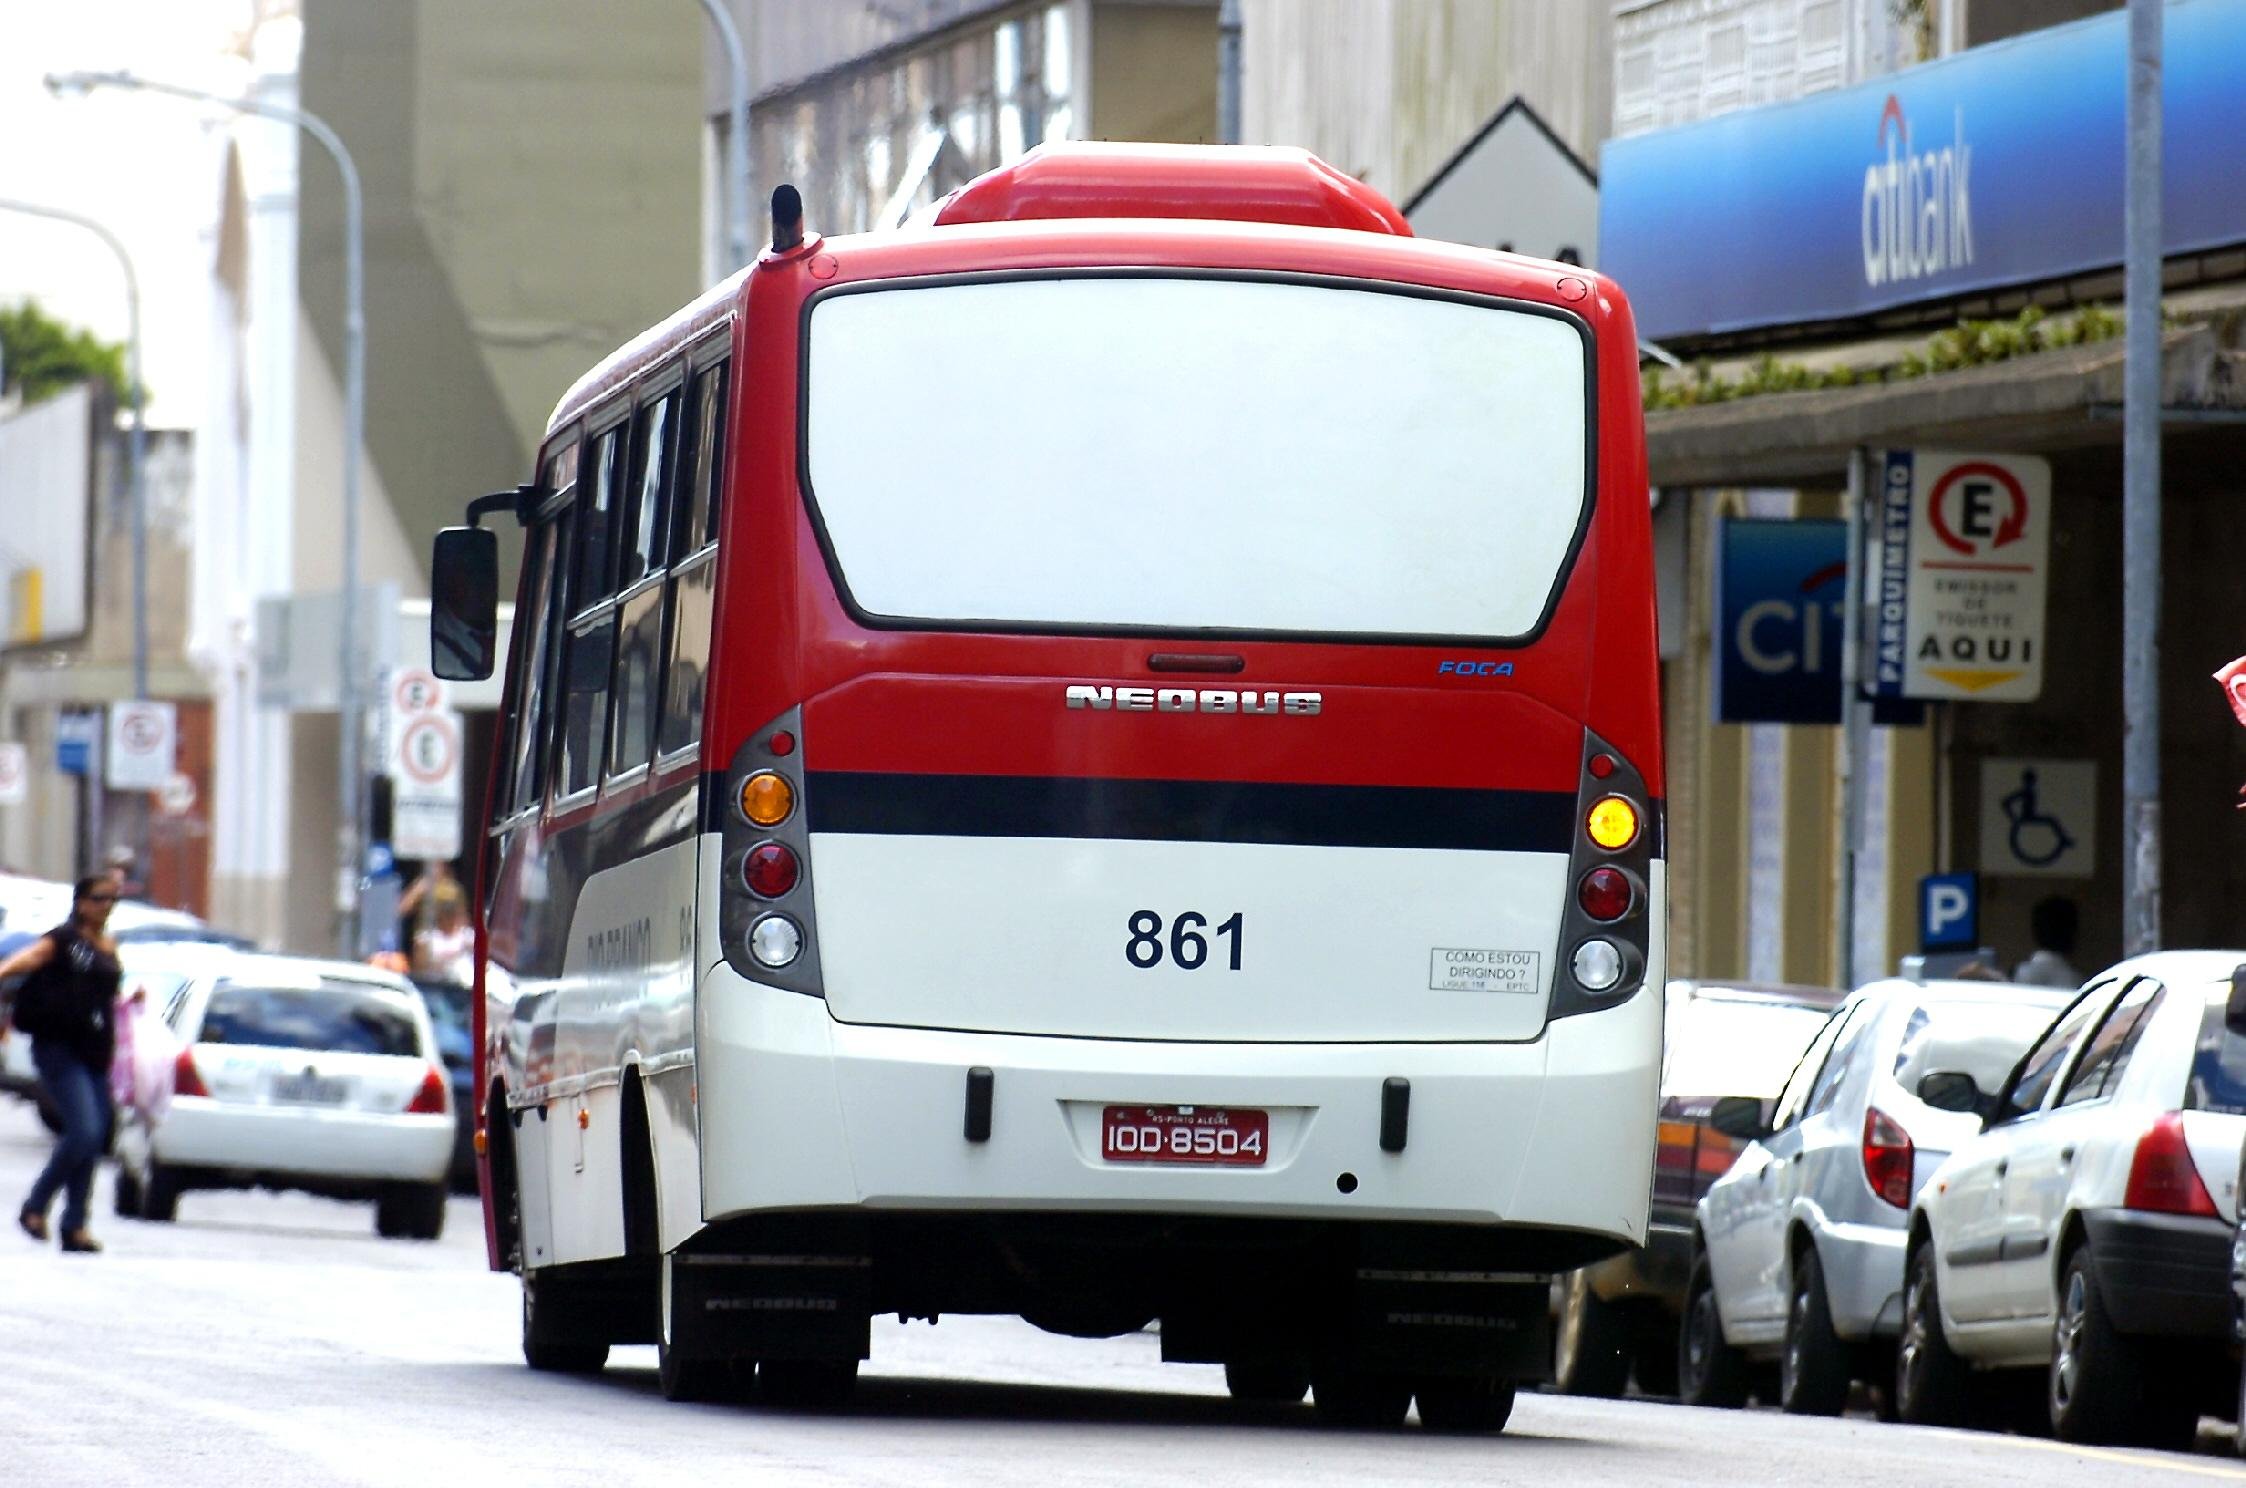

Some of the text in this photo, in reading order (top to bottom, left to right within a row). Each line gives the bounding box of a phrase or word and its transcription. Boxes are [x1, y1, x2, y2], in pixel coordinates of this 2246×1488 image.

[1962, 484, 1993, 537] E
[1919, 635, 2031, 663] AQUI
[1438, 661, 1514, 676] FOCA
[1066, 685, 1322, 715] NEOBUS
[1929, 885, 1969, 934] P
[1125, 909, 1243, 971] 861
[1445, 951, 1530, 965] COMO ESTOU
[1450, 966, 1515, 980] DIRIGINDO
